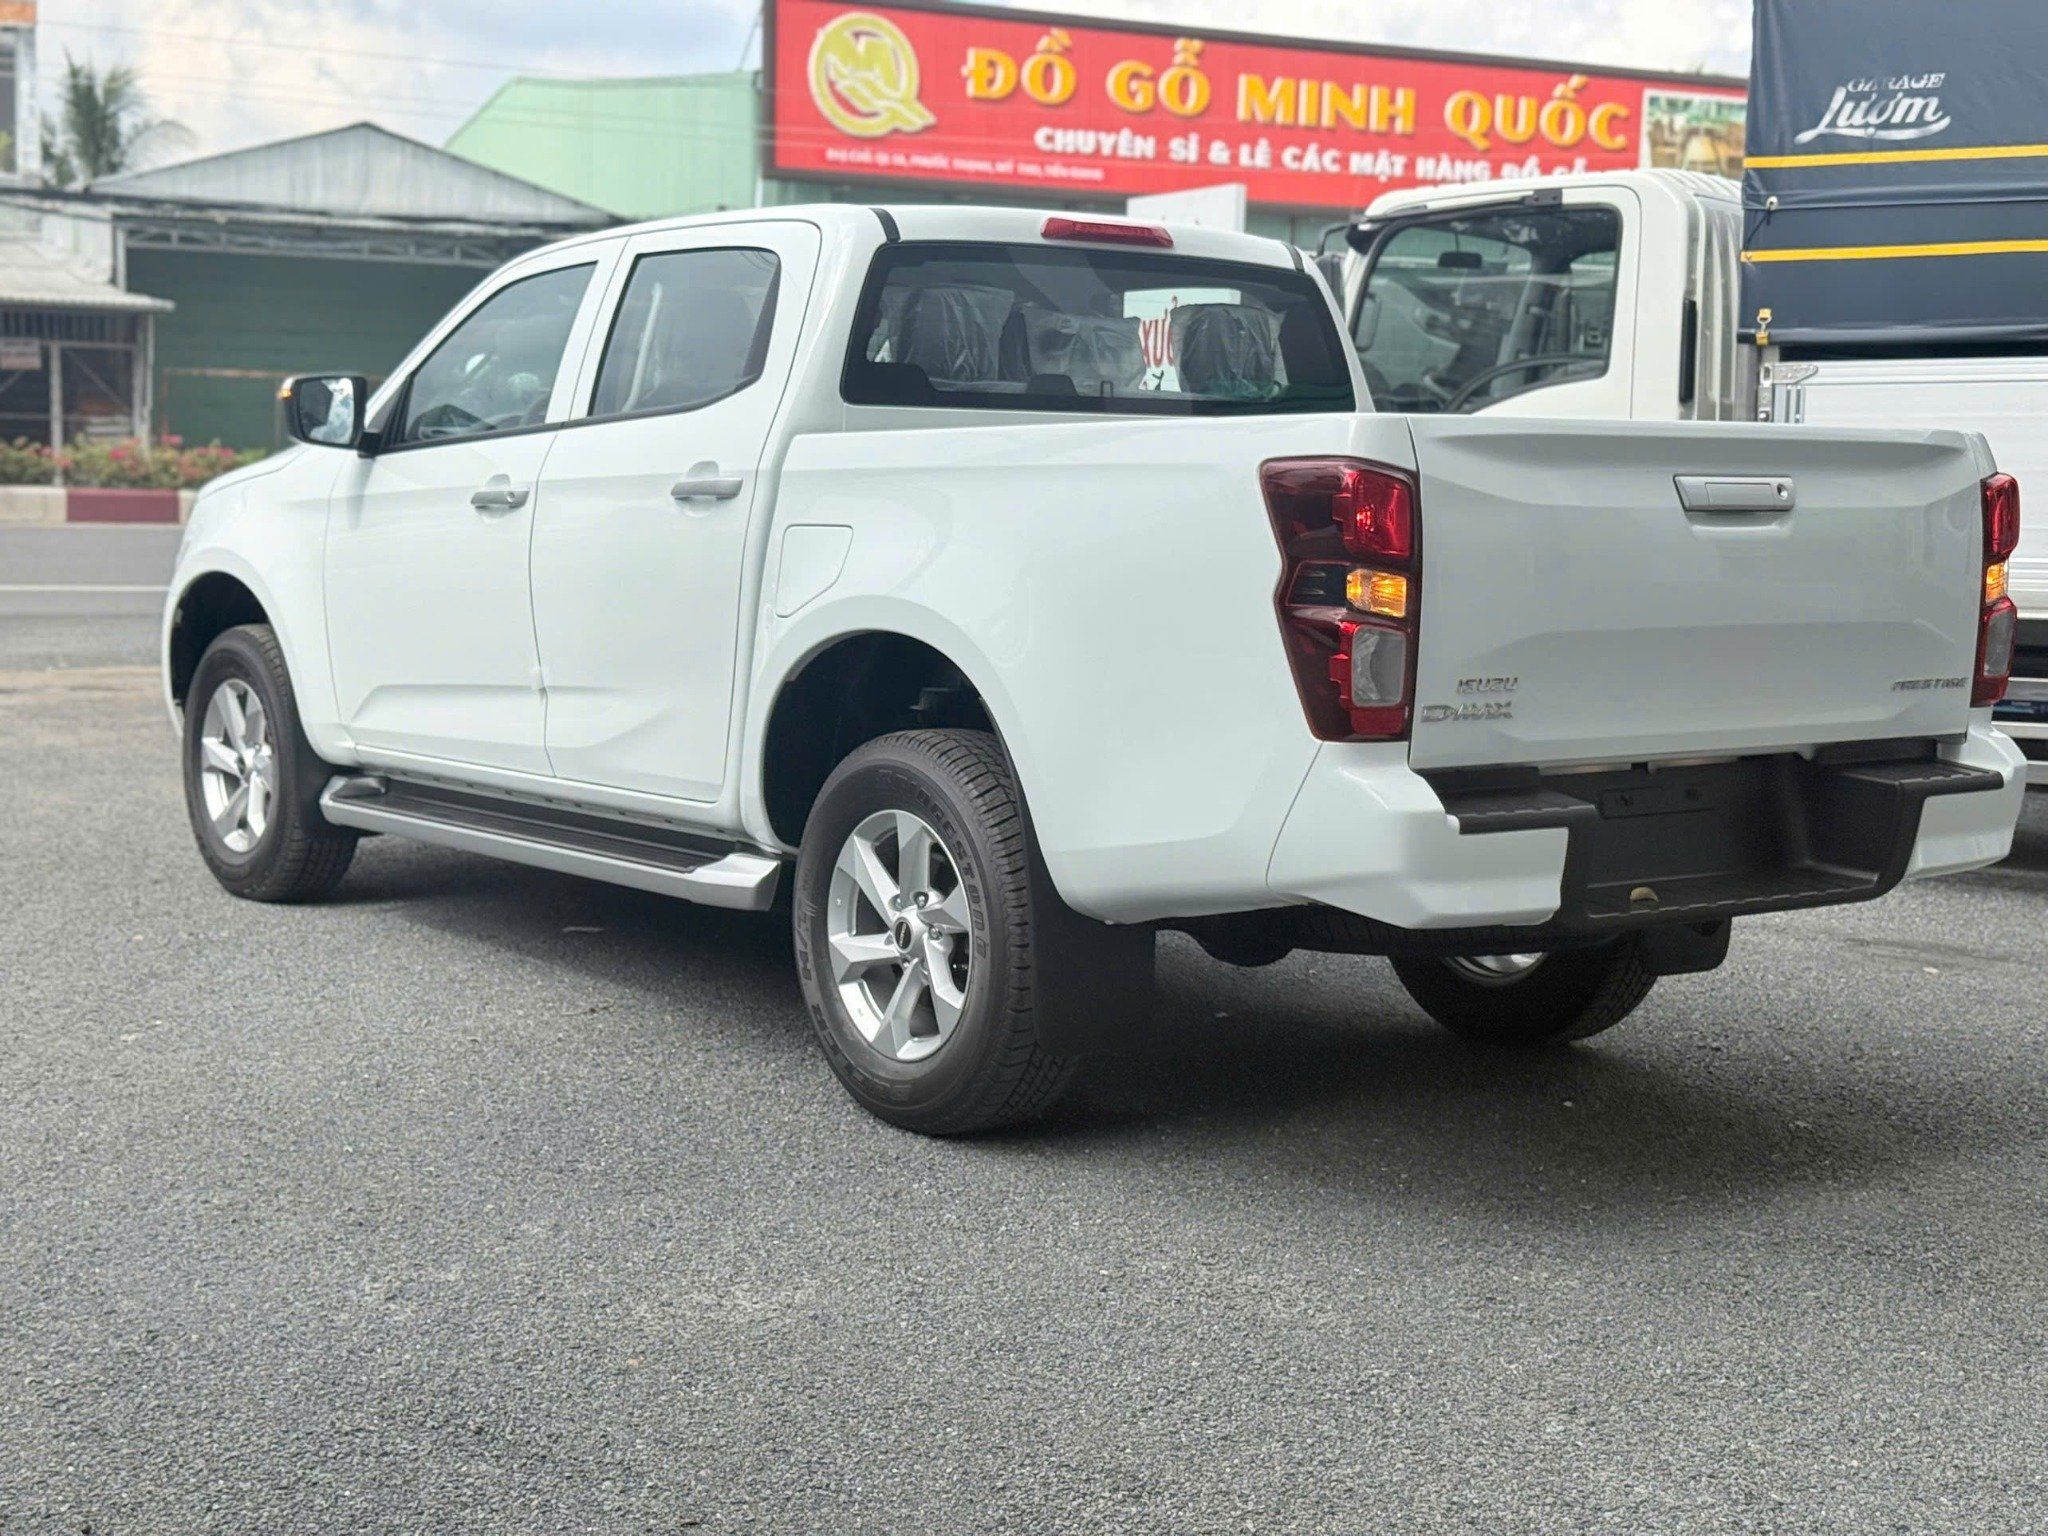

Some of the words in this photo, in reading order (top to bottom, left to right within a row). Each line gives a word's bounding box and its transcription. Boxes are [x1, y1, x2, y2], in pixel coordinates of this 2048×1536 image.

[962, 28, 1077, 106] ĐỒ
[1106, 38, 1211, 117] GỖ
[1236, 73, 1417, 135] MINH
[1444, 74, 1631, 152] QUỐC
[1034, 126, 1156, 160] CHUYÊN
[1207, 139, 1230, 166] &
[1281, 142, 1341, 173] CÁC
[1415, 152, 1491, 182] HÀNG
[1456, 677, 1519, 695] ISUZU
